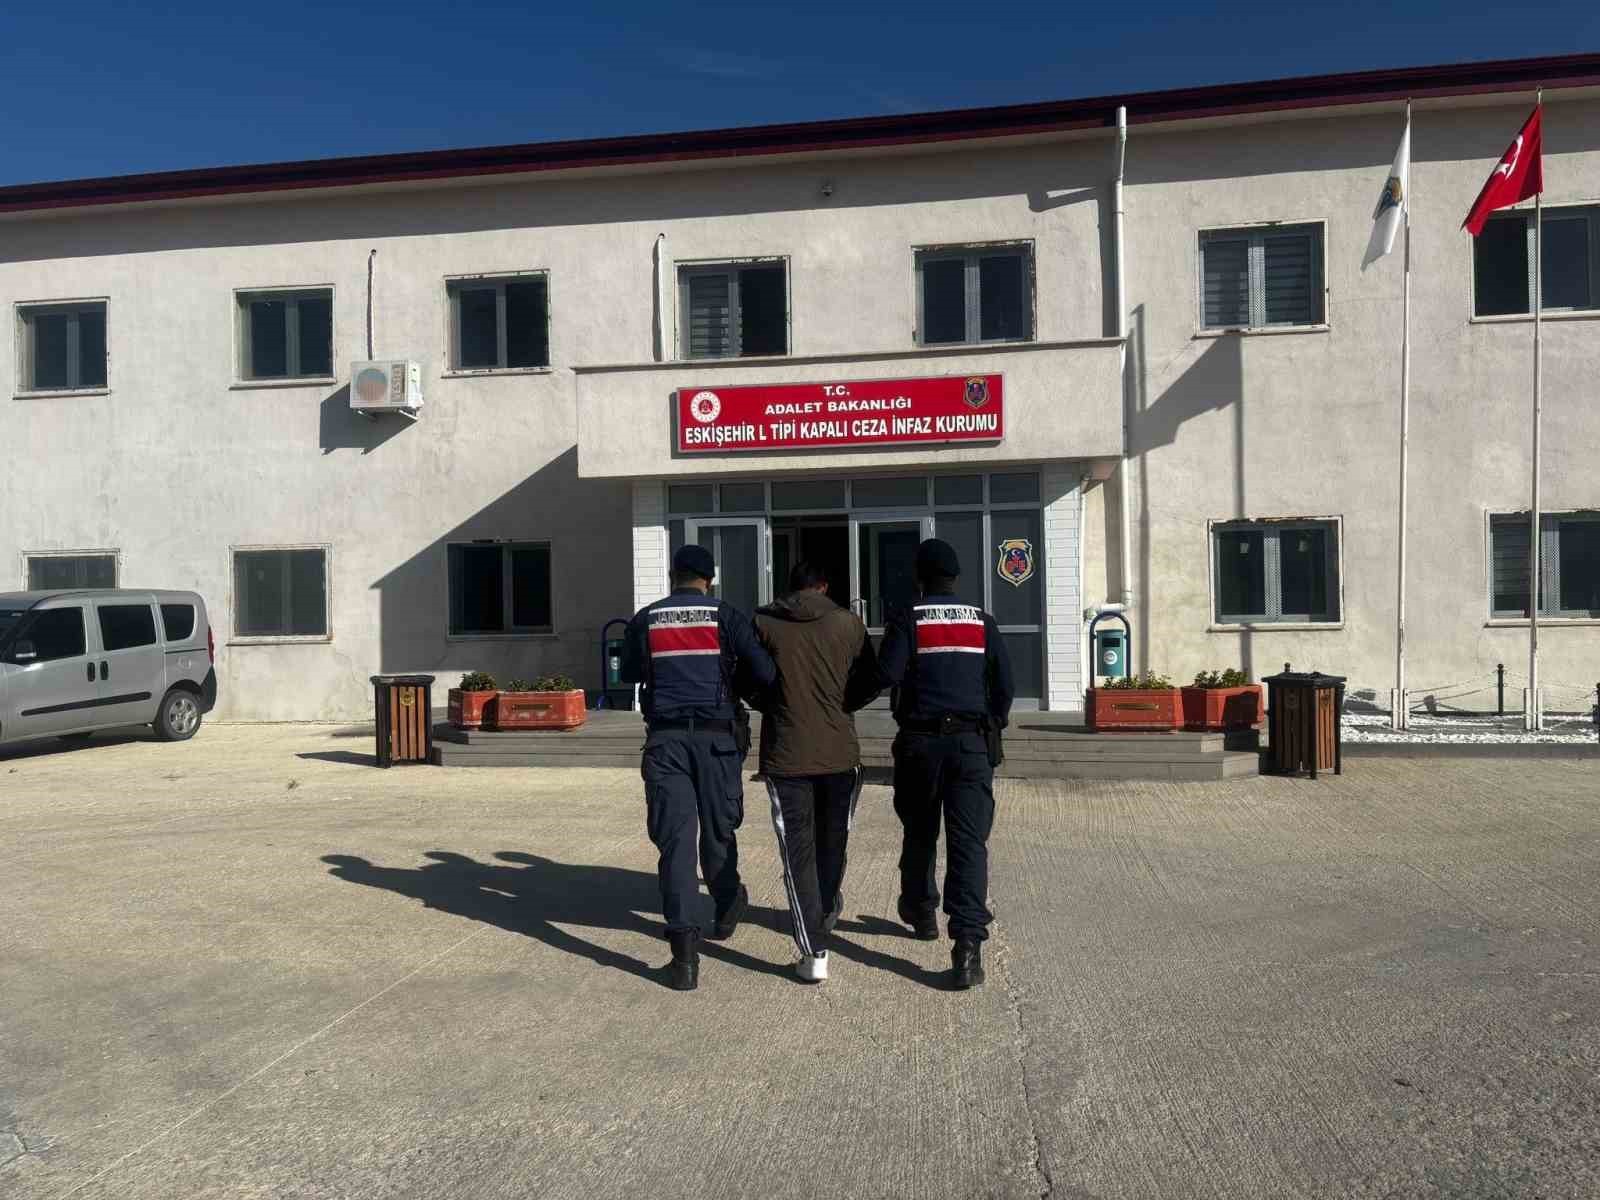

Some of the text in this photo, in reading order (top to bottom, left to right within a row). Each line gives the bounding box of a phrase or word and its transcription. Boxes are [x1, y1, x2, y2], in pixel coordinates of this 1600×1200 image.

[823, 385, 850, 396] T.C.
[765, 397, 912, 415] ADALET BAKANLIĞI
[685, 413, 998, 447] ESKİŞEHİR L TİPİ KAPALI CEZA İNFAZ KURUMU
